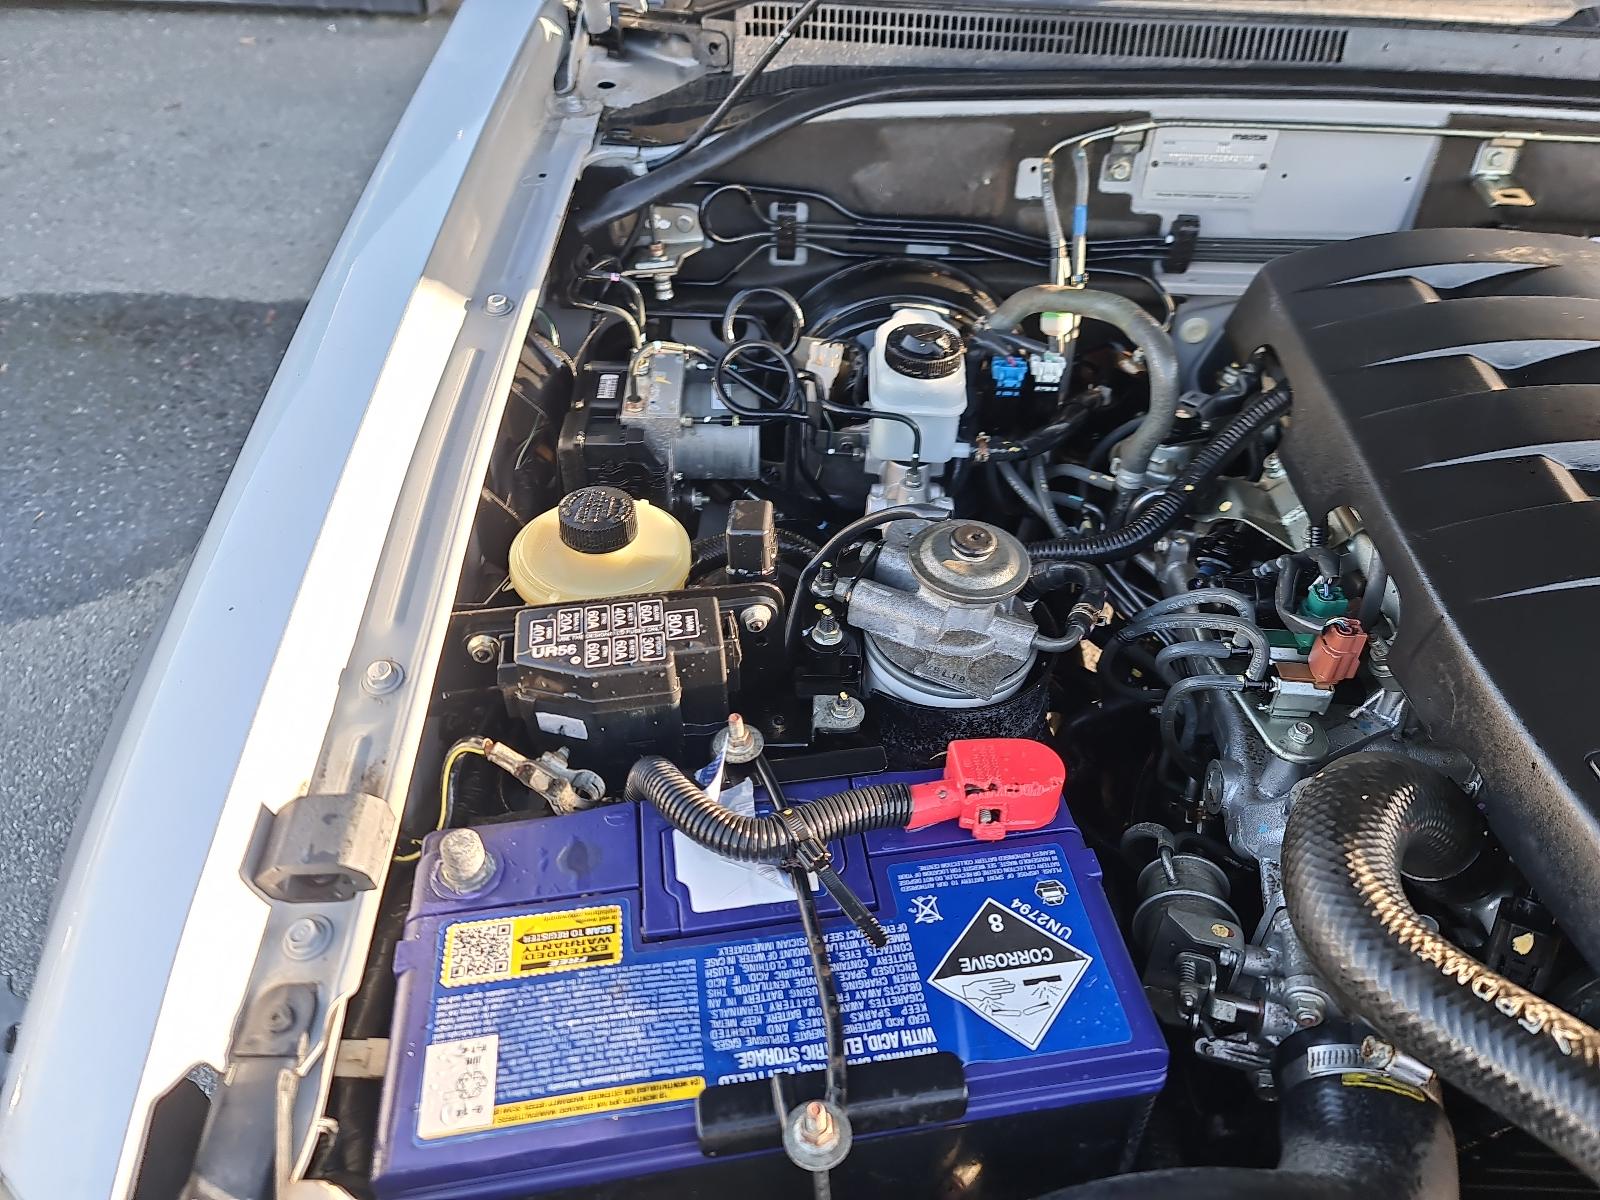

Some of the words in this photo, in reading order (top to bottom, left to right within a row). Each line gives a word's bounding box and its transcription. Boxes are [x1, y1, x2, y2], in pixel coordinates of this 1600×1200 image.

[587, 610, 599, 630] 60A
[613, 607, 627, 627] 40A
[640, 605, 653, 624] 60A
[560, 613, 573, 633] 20A
[667, 613, 683, 637] 80A
[532, 624, 545, 644] 40A
[531, 644, 577, 659] UR56
[588, 643, 601, 663] 60A
[614, 640, 628, 660] 60A
[643, 637, 656, 656] 30A
[1006, 872, 1014, 880] OF
[988, 914, 1004, 932] 8
[1010, 898, 1072, 940] UN2794
[569, 928, 583, 938] TO
[584, 924, 614, 936] SCAN
[896, 922, 908, 932] OF
[522, 930, 569, 944] REGISTER
[828, 932, 844, 942] SEE
[522, 936, 612, 954] WARRANTY
[522, 944, 608, 960] EXTENDED
[839, 938, 860, 952] WITH
[866, 942, 913, 957] CONTACTS
[546, 956, 588, 967] FREE
[704, 956, 726, 968] CASE
[726, 956, 736, 965] IN
[766, 950, 778, 962] OF
[792, 956, 806, 968] OR
[876, 951, 915, 966] BATTERY
[958, 947, 1054, 972] CORROSIVE
[704, 966, 734, 978] FLUSH
[870, 962, 918, 977] ENCLOSED
[705, 976, 727, 988] ACID
[731, 974, 740, 985] IF
[840, 976, 888, 992] CHARGING
[892, 972, 920, 984] WHEN
[706, 988, 728, 998] THIS
[788, 986, 818, 998] USING
[854, 988, 882, 1000] AWAY
[882, 982, 922, 996] OBJECTS
[706, 998, 722, 1008] AN
[725, 997, 738, 1006] IN
[742, 990, 784, 1005] BATTERY
[868, 992, 924, 1008] CIGARETTES
[768, 998, 816, 1012] BATTERY
[840, 1000, 864, 1012] AWAY
[900, 1002, 928, 1015] KEEP
[707, 1018, 738, 1028] METAL
[740, 1016, 762, 1026] KEEP
[884, 1016, 905, 1028] ACID
[908, 1012, 930, 1026] LEAD
[709, 1026, 756, 1040] LIGHTED
[766, 1022, 788, 1034] AND
[842, 1019, 882, 1034] BATTERIE
[744, 1034, 790, 1046] EXPLOSIVE
[862, 1030, 899, 1052] ACID,
[900, 1026, 938, 1048] WITH
